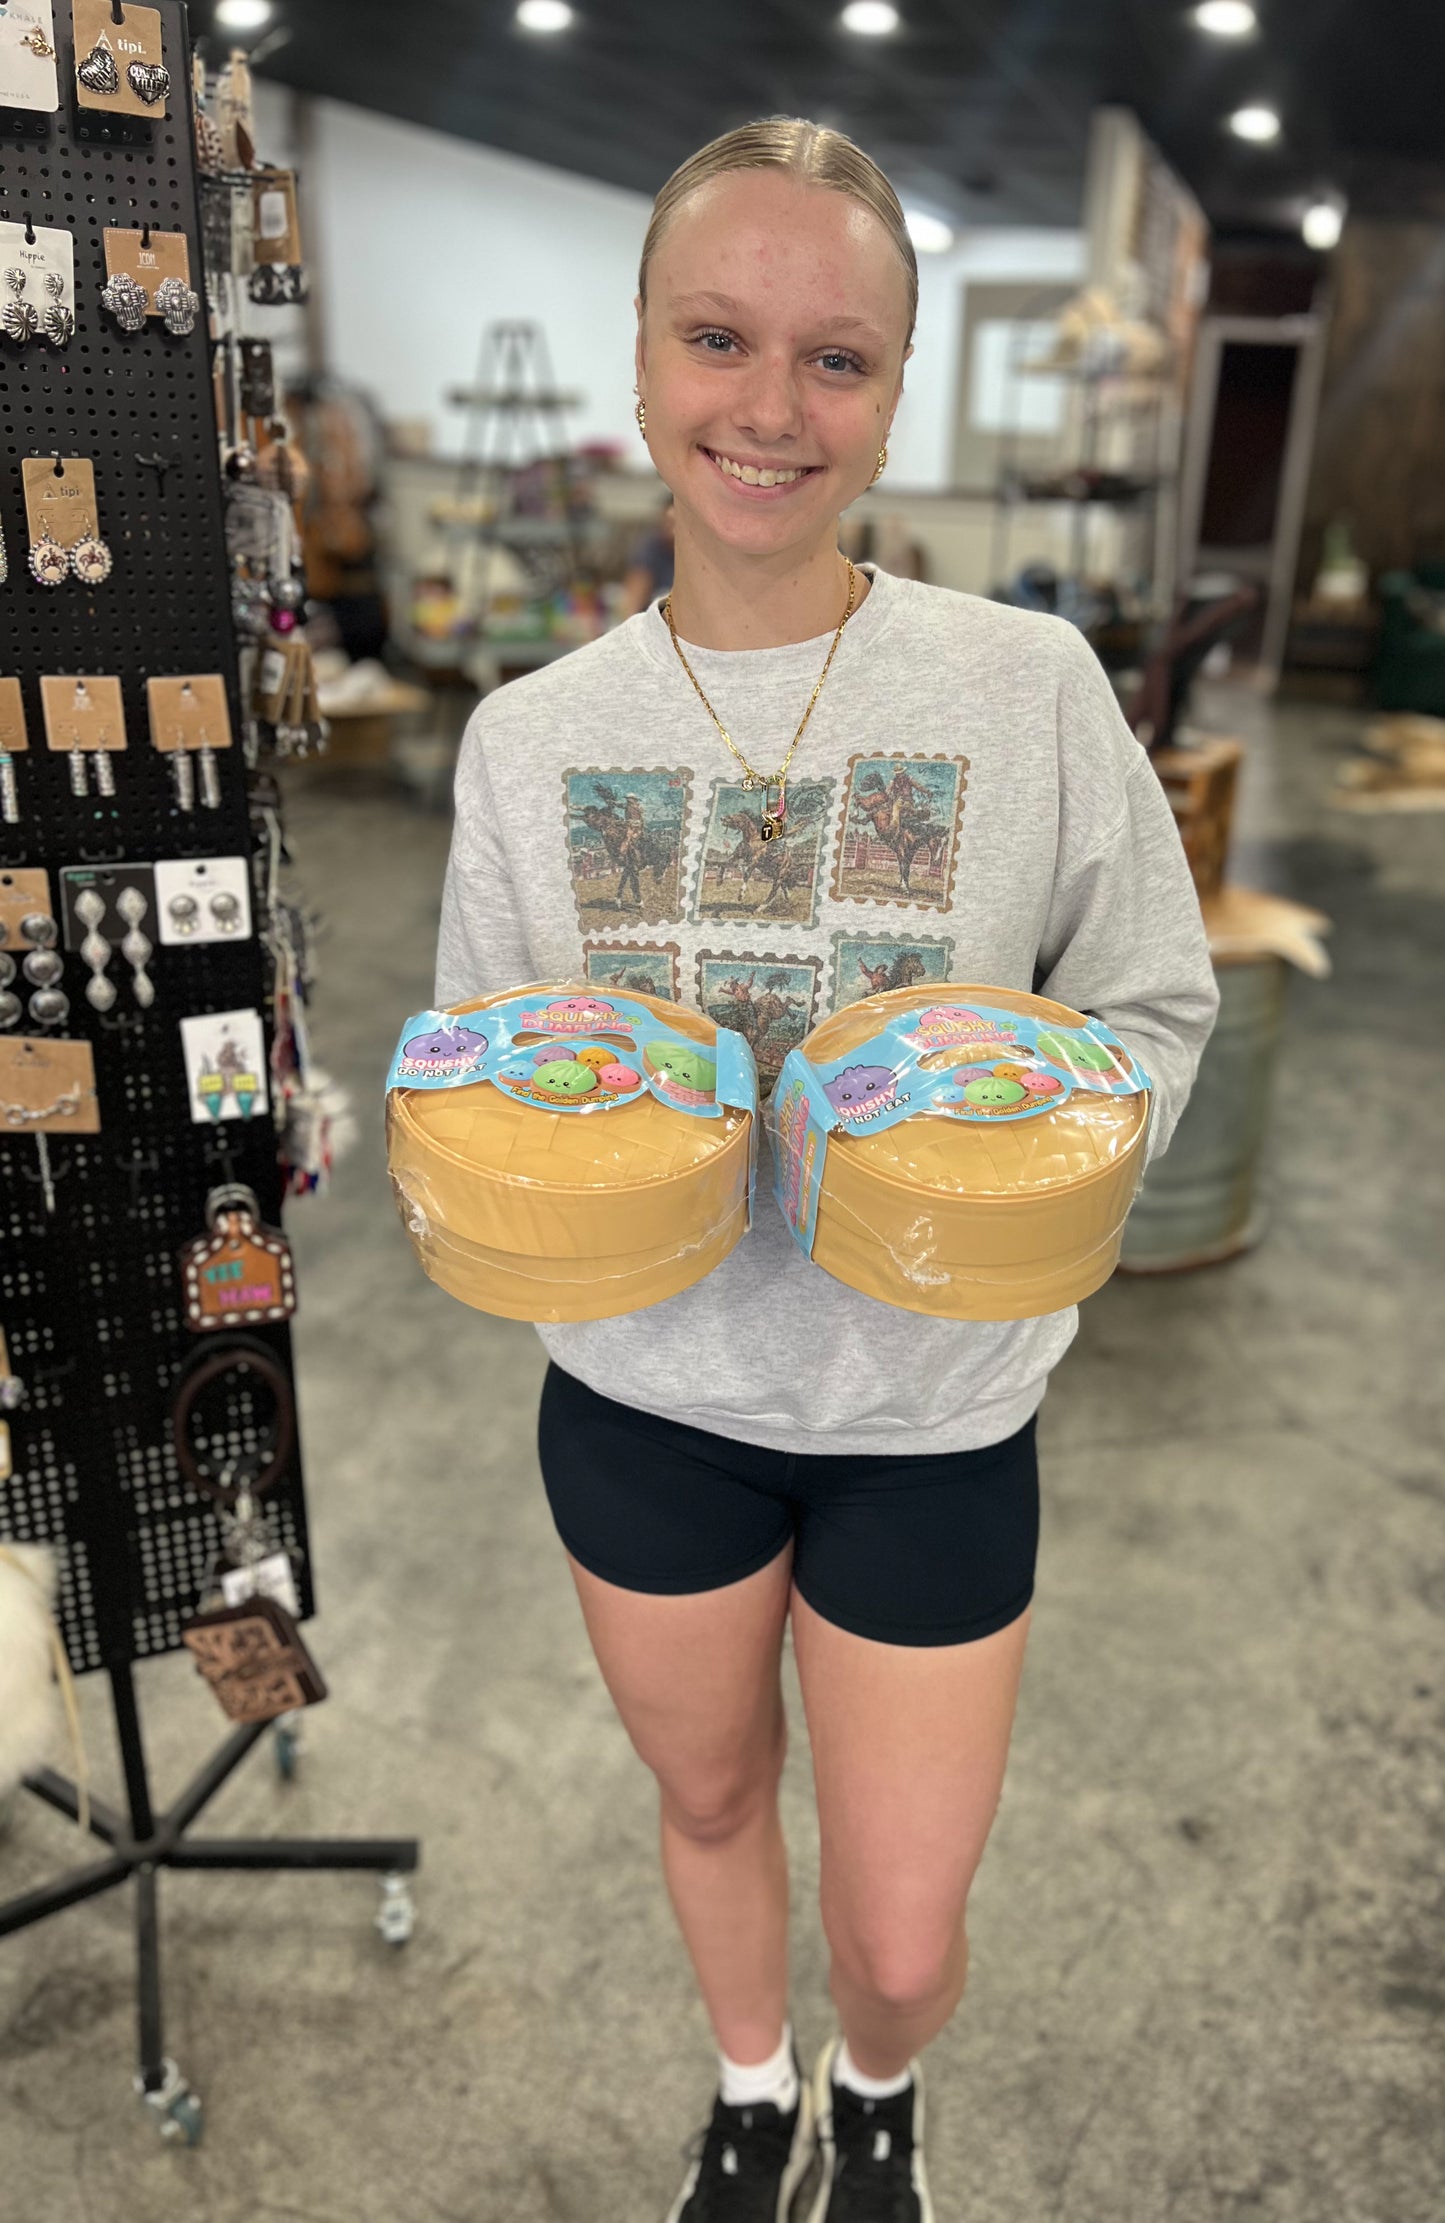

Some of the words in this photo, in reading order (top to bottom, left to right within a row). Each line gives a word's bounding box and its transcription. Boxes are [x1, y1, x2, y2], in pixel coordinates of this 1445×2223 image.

[19, 250, 46, 264] Hippie
[60, 486, 80, 498] tipi
[917, 1020, 996, 1036] SQUISHY
[402, 1054, 479, 1070] SQUISHY
[398, 1066, 418, 1076] DO
[423, 1069, 454, 1078] NOT
[549, 1095, 579, 1105] Golden
[854, 1109, 881, 1125] NOT
[884, 1092, 911, 1113] EAT
[992, 1104, 1021, 1115] Golden
